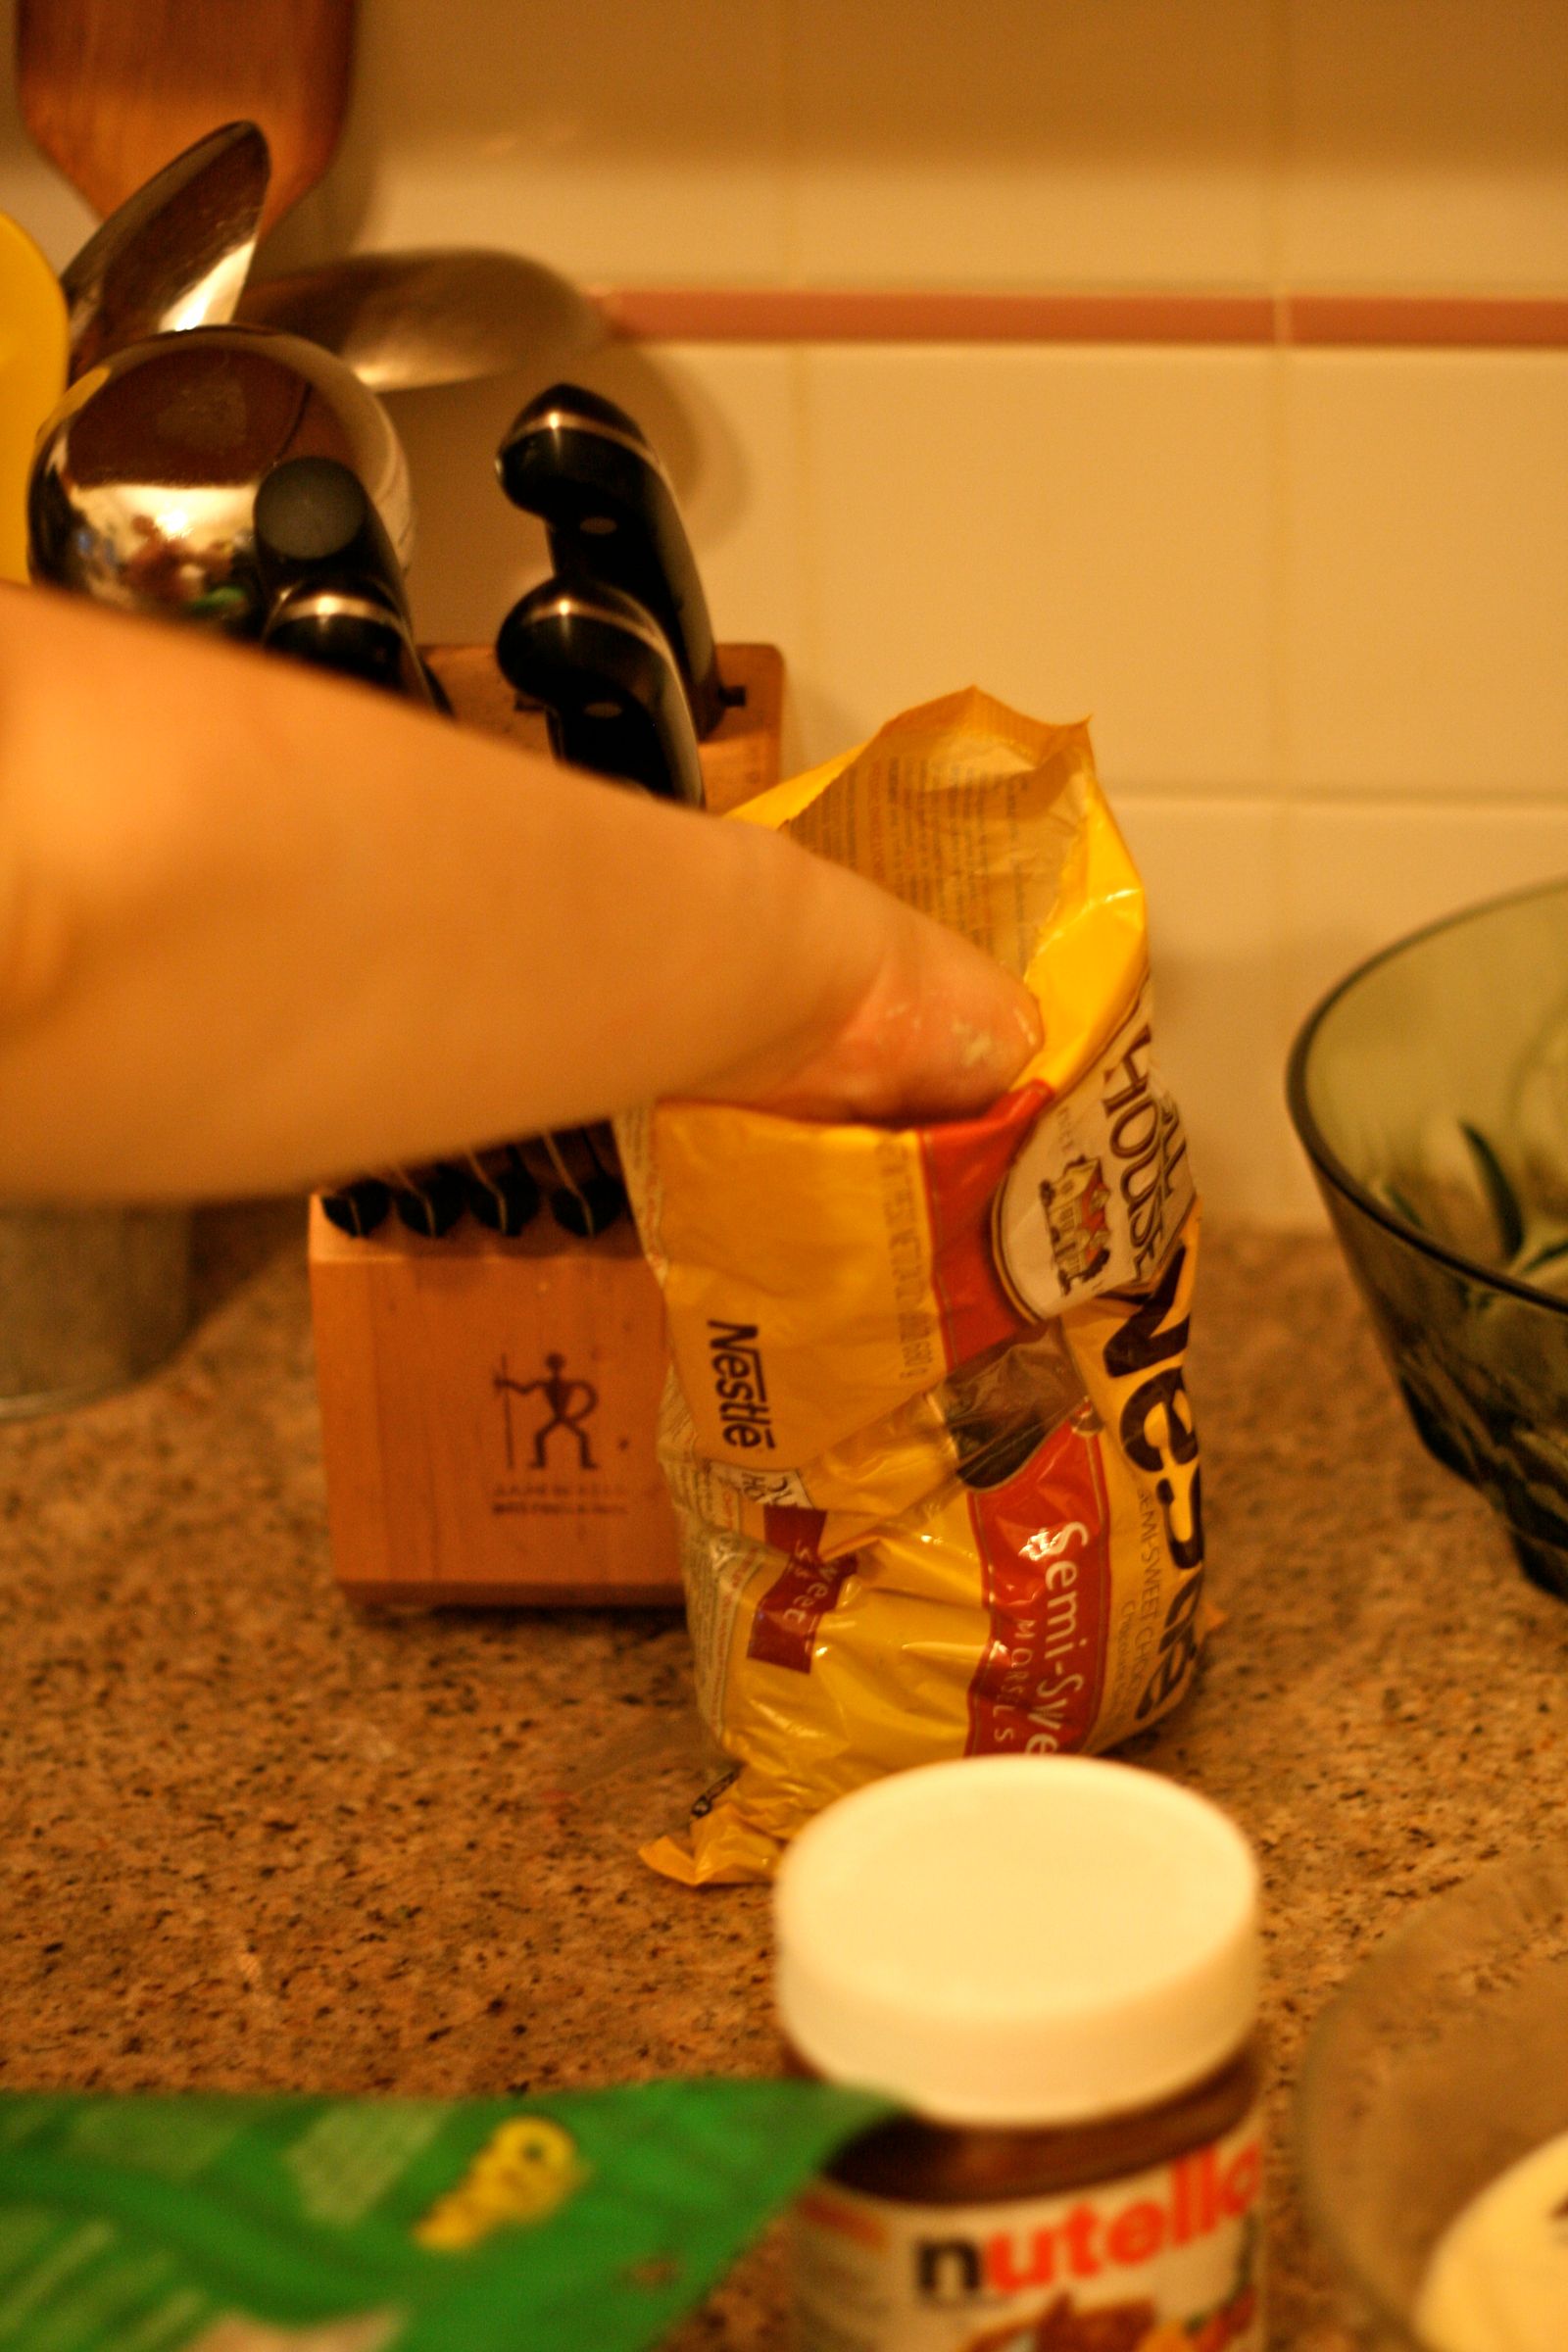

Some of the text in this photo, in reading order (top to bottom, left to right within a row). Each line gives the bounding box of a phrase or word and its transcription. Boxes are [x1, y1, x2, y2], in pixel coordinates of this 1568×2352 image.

[707, 1319, 776, 1448] Nestlé
[1025, 1522, 1089, 1755] Semi-Swe
[914, 2143, 1261, 2297] nutella
